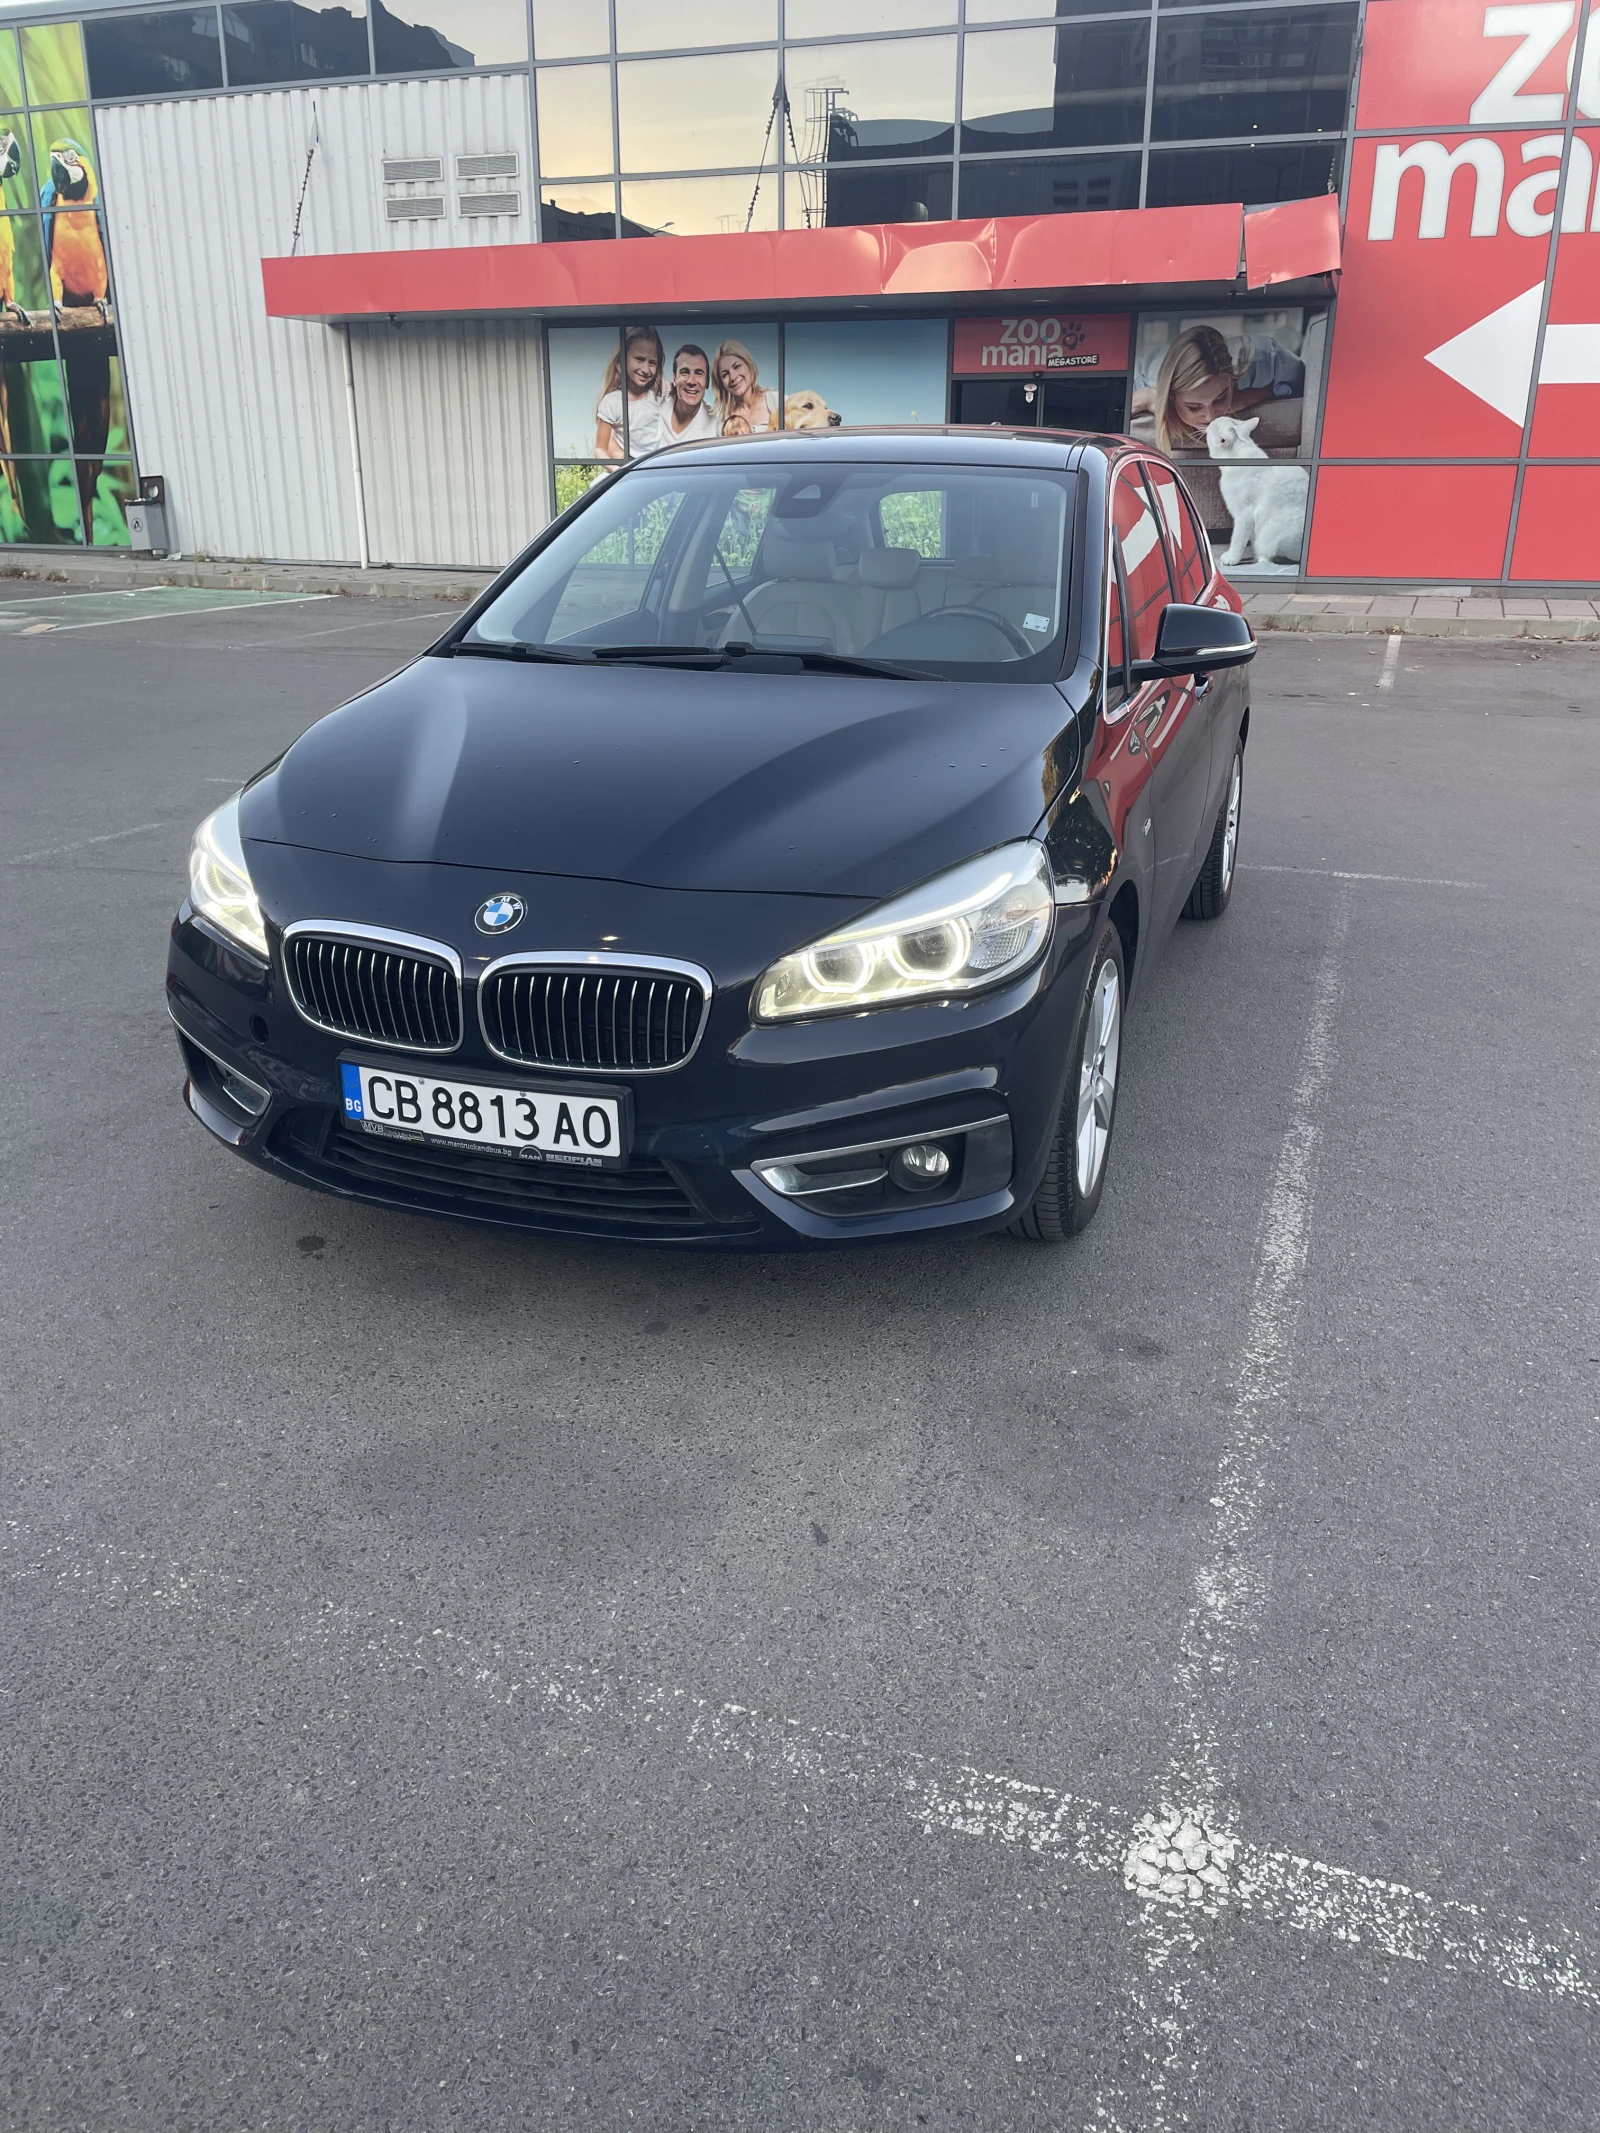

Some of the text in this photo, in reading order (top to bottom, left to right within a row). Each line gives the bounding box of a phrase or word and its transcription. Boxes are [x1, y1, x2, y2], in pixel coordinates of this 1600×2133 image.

[1367, 134, 1600, 241] ma
[981, 344, 1063, 366] mania
[1048, 355, 1098, 367] MEGASTORE
[345, 1098, 362, 1113] BG
[368, 1076, 611, 1149] CB 8813 AO
[431, 1138, 512, 1157] www.mantruckandbus.bg
